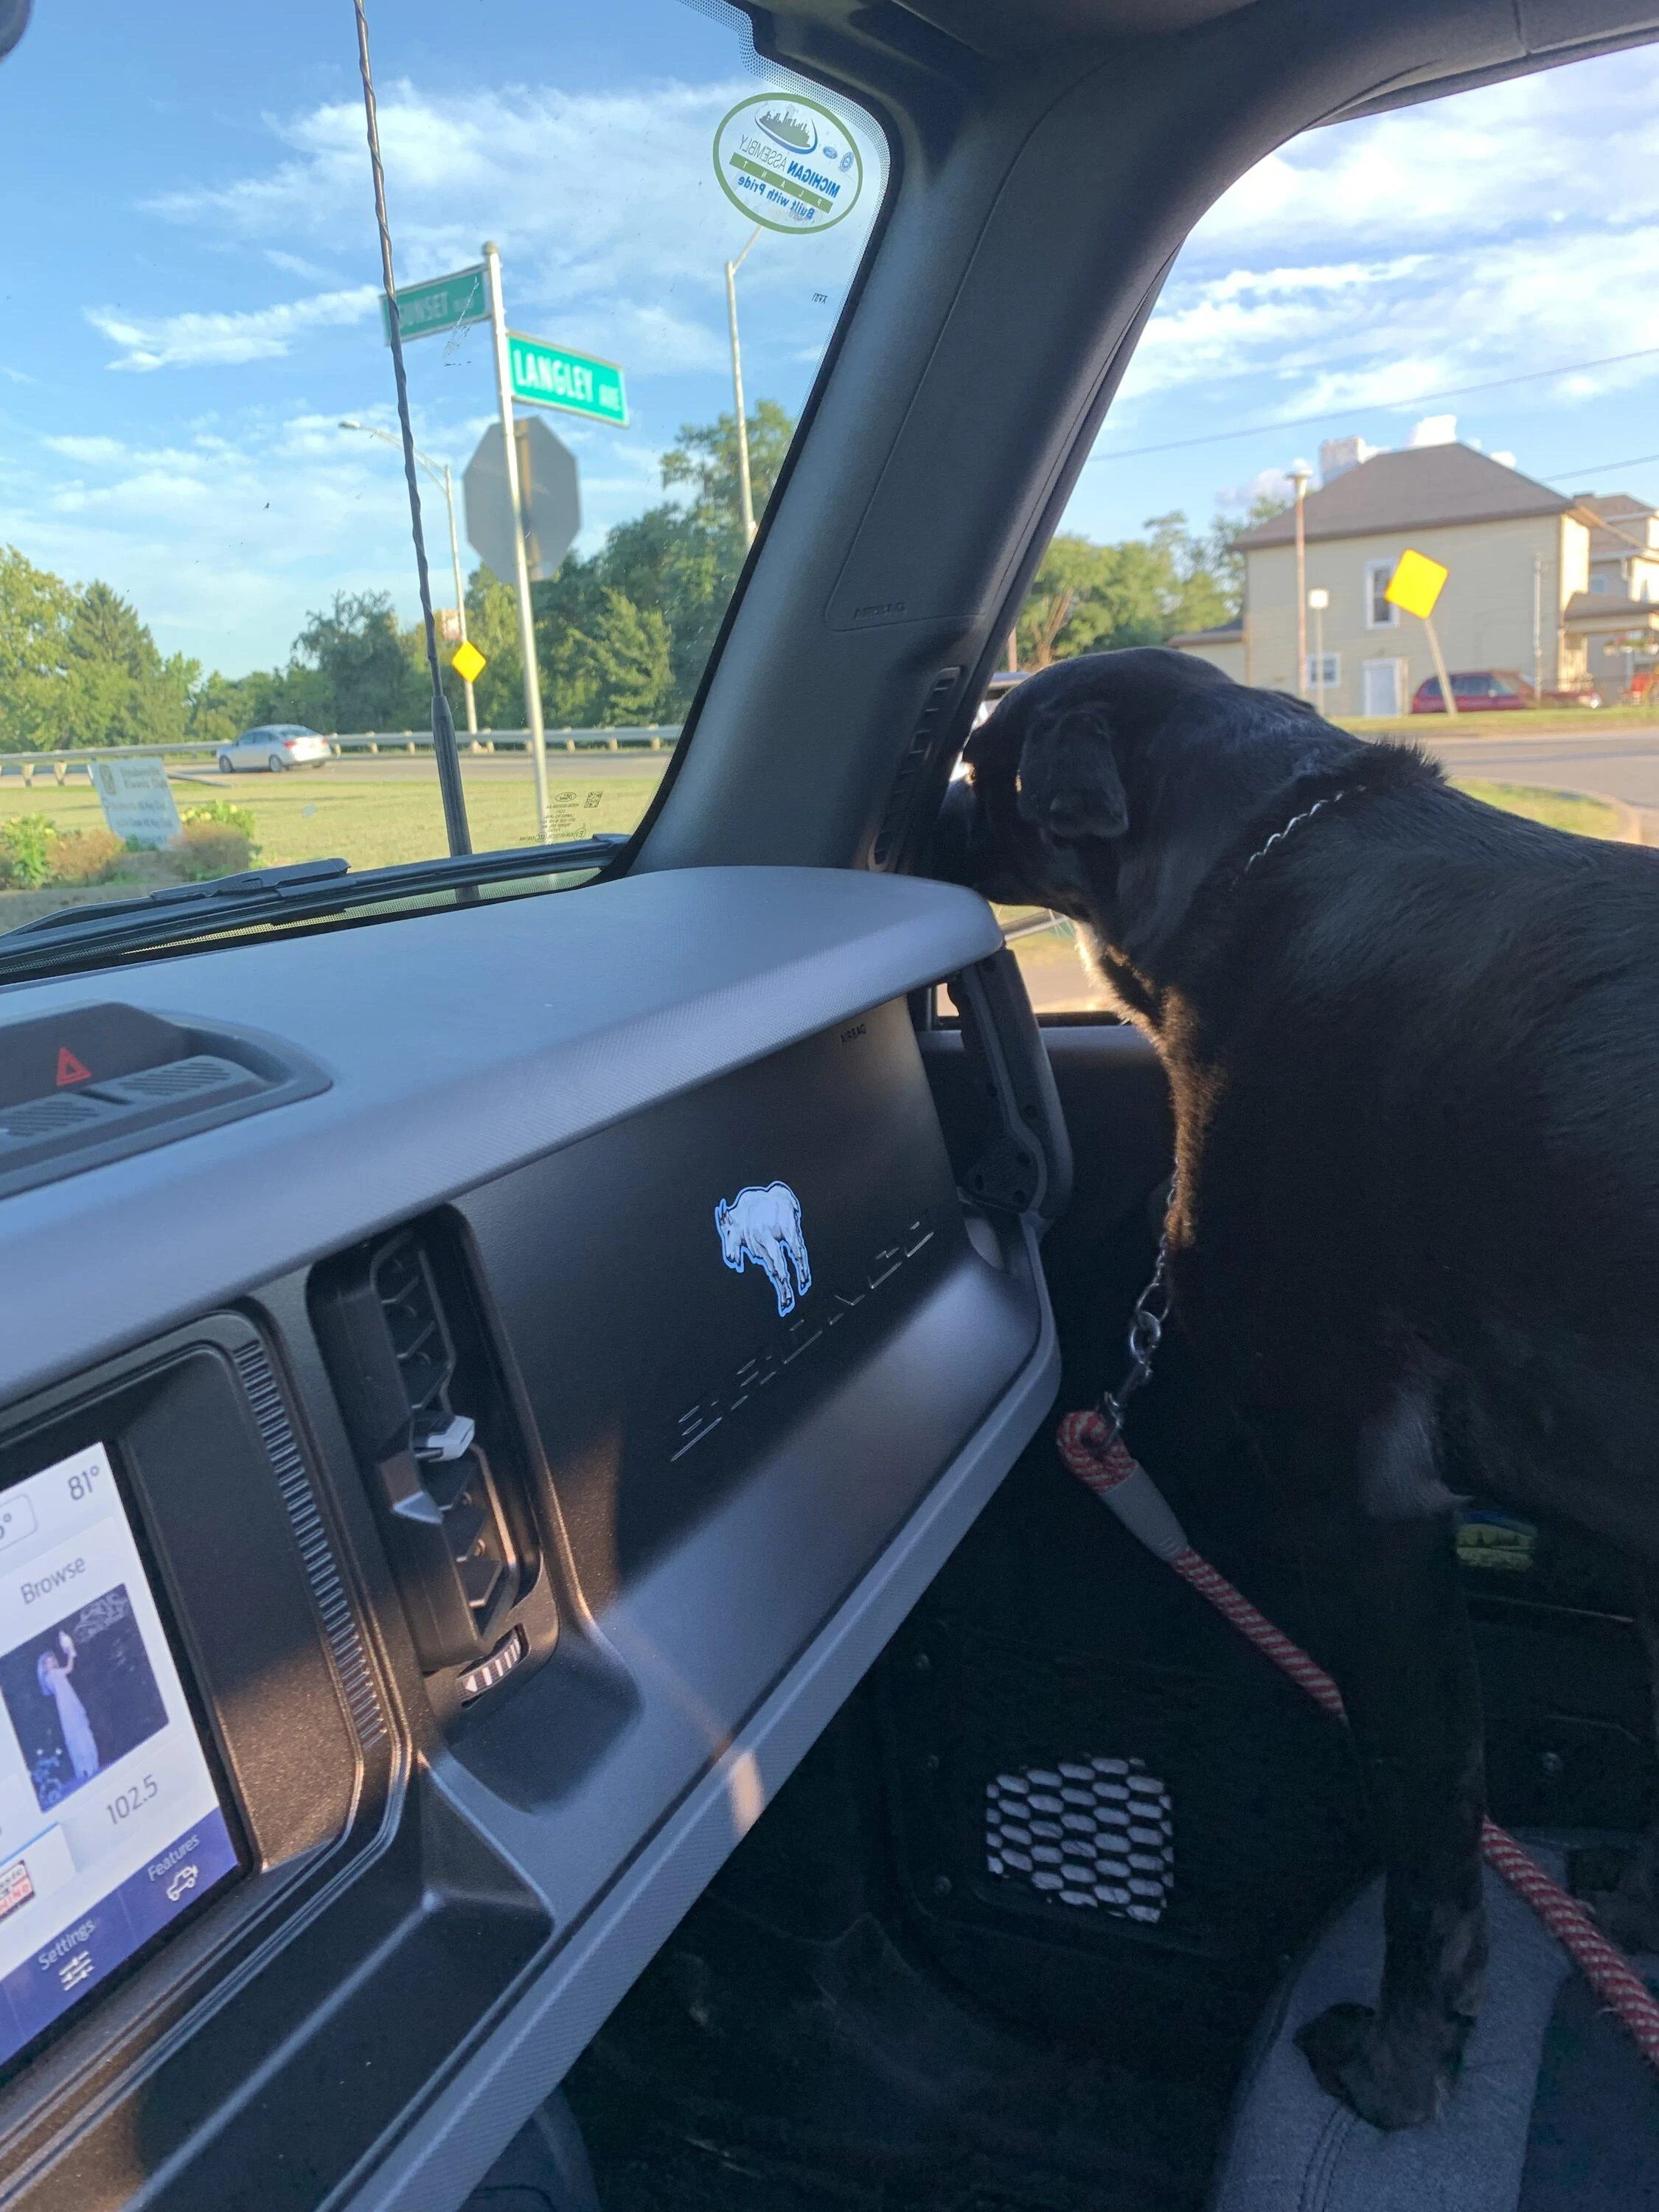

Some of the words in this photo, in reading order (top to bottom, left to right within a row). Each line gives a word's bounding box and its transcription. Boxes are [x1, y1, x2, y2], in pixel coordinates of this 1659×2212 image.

[513, 349, 594, 403] LANGLEY
[67, 1465, 100, 1501] 81°
[21, 1557, 86, 1605] Browse
[105, 1774, 159, 1825] 102.5
[147, 1834, 201, 1882] Features
[38, 1919, 97, 1970] Settings
